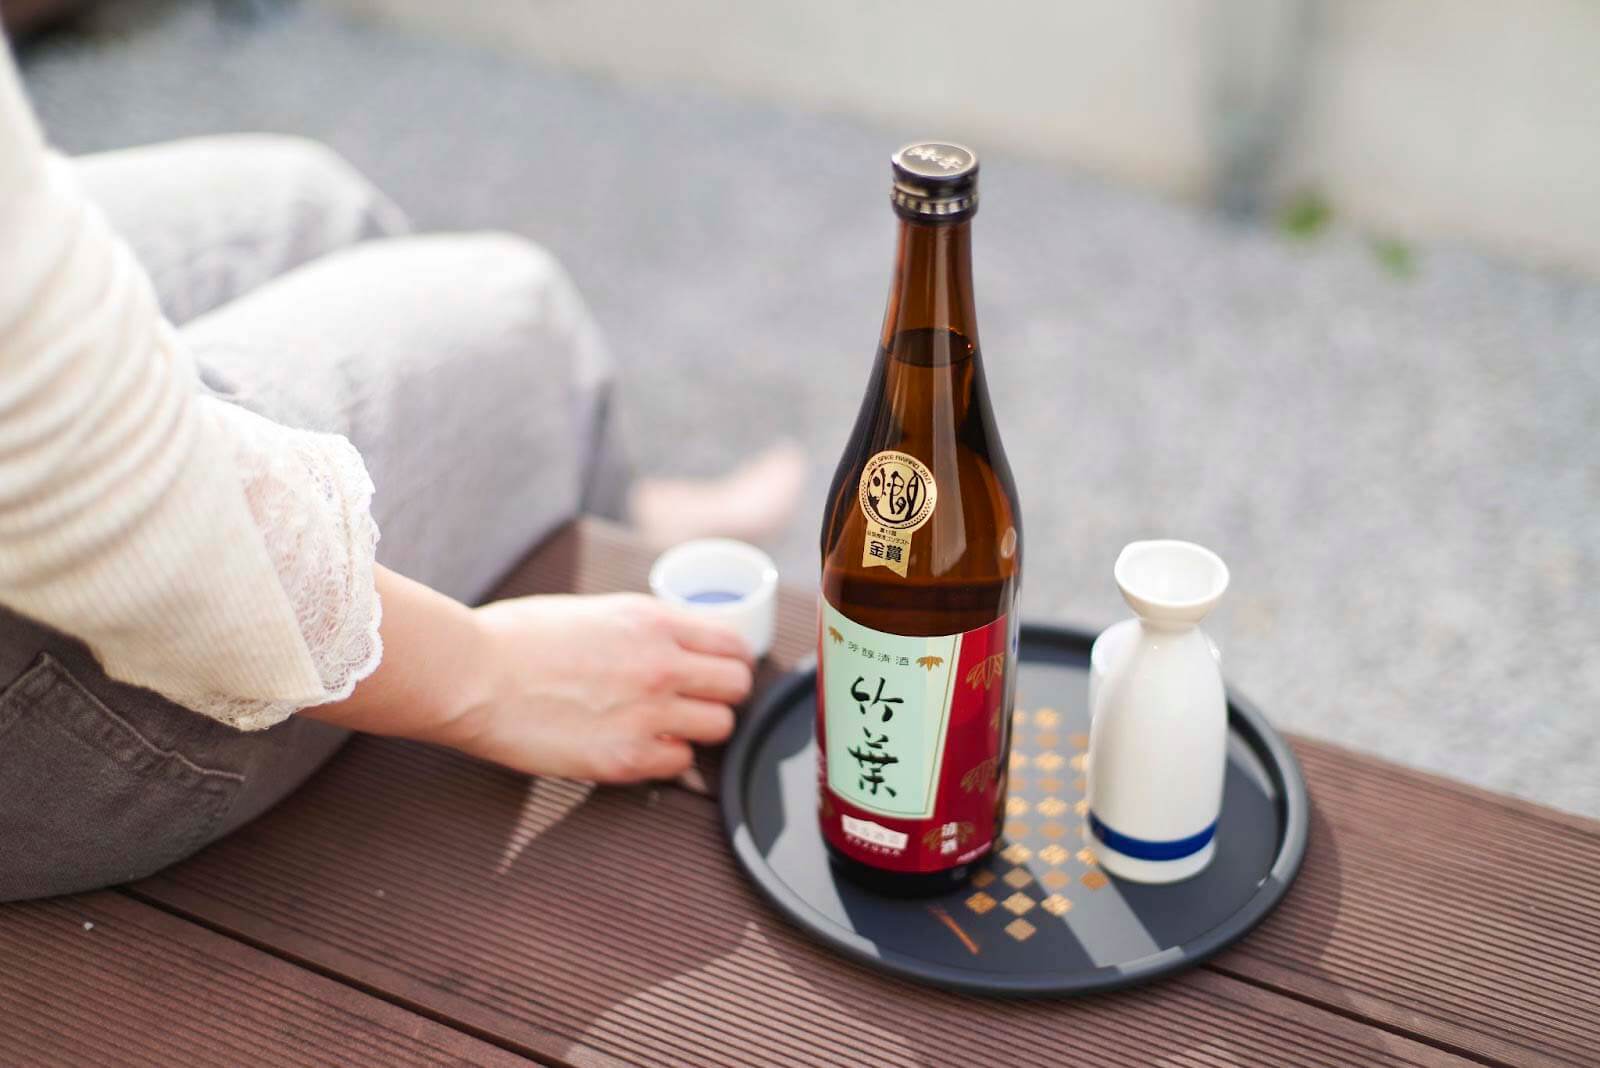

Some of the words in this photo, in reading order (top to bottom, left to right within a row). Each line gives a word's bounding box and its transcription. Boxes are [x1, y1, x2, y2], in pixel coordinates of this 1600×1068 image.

[919, 467, 933, 485] 2021
[869, 540, 903, 563] 金賞
[848, 641, 909, 666] 芳醇清酒
[847, 676, 905, 798] 竹葉
